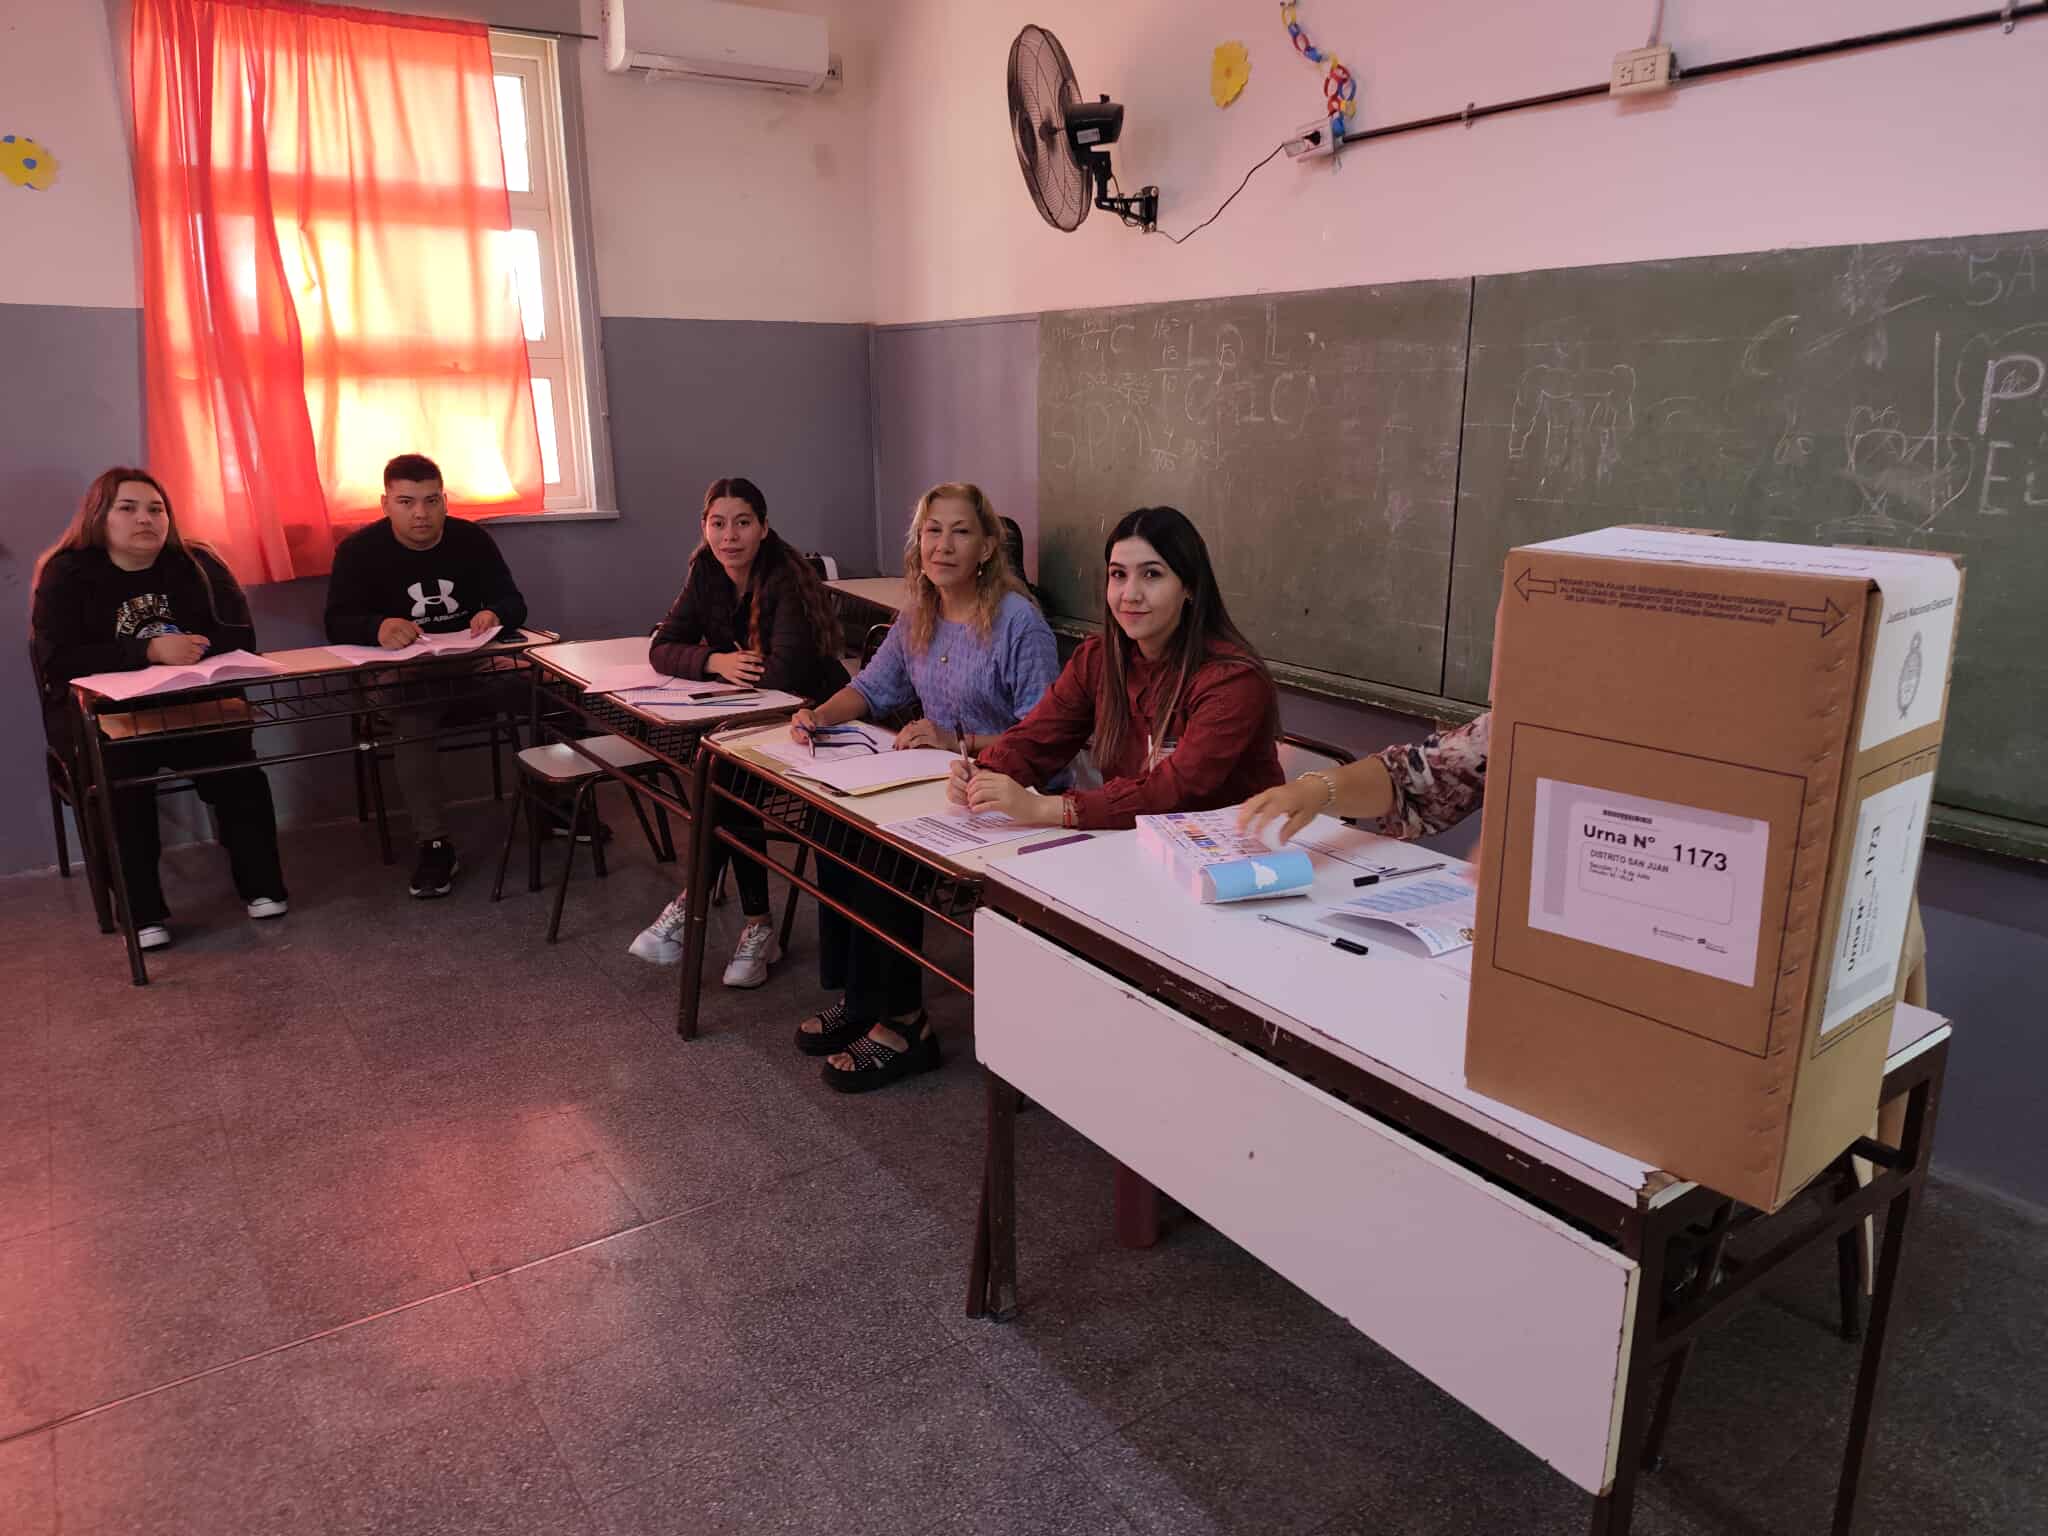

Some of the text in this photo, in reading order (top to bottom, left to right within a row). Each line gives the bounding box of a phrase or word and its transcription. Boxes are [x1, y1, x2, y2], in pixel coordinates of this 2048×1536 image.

[1583, 824, 1628, 845] Urna
[1673, 843, 1728, 872] 1173
[1590, 849, 1627, 864] DISTRITO
[1628, 857, 1645, 868] SAN
